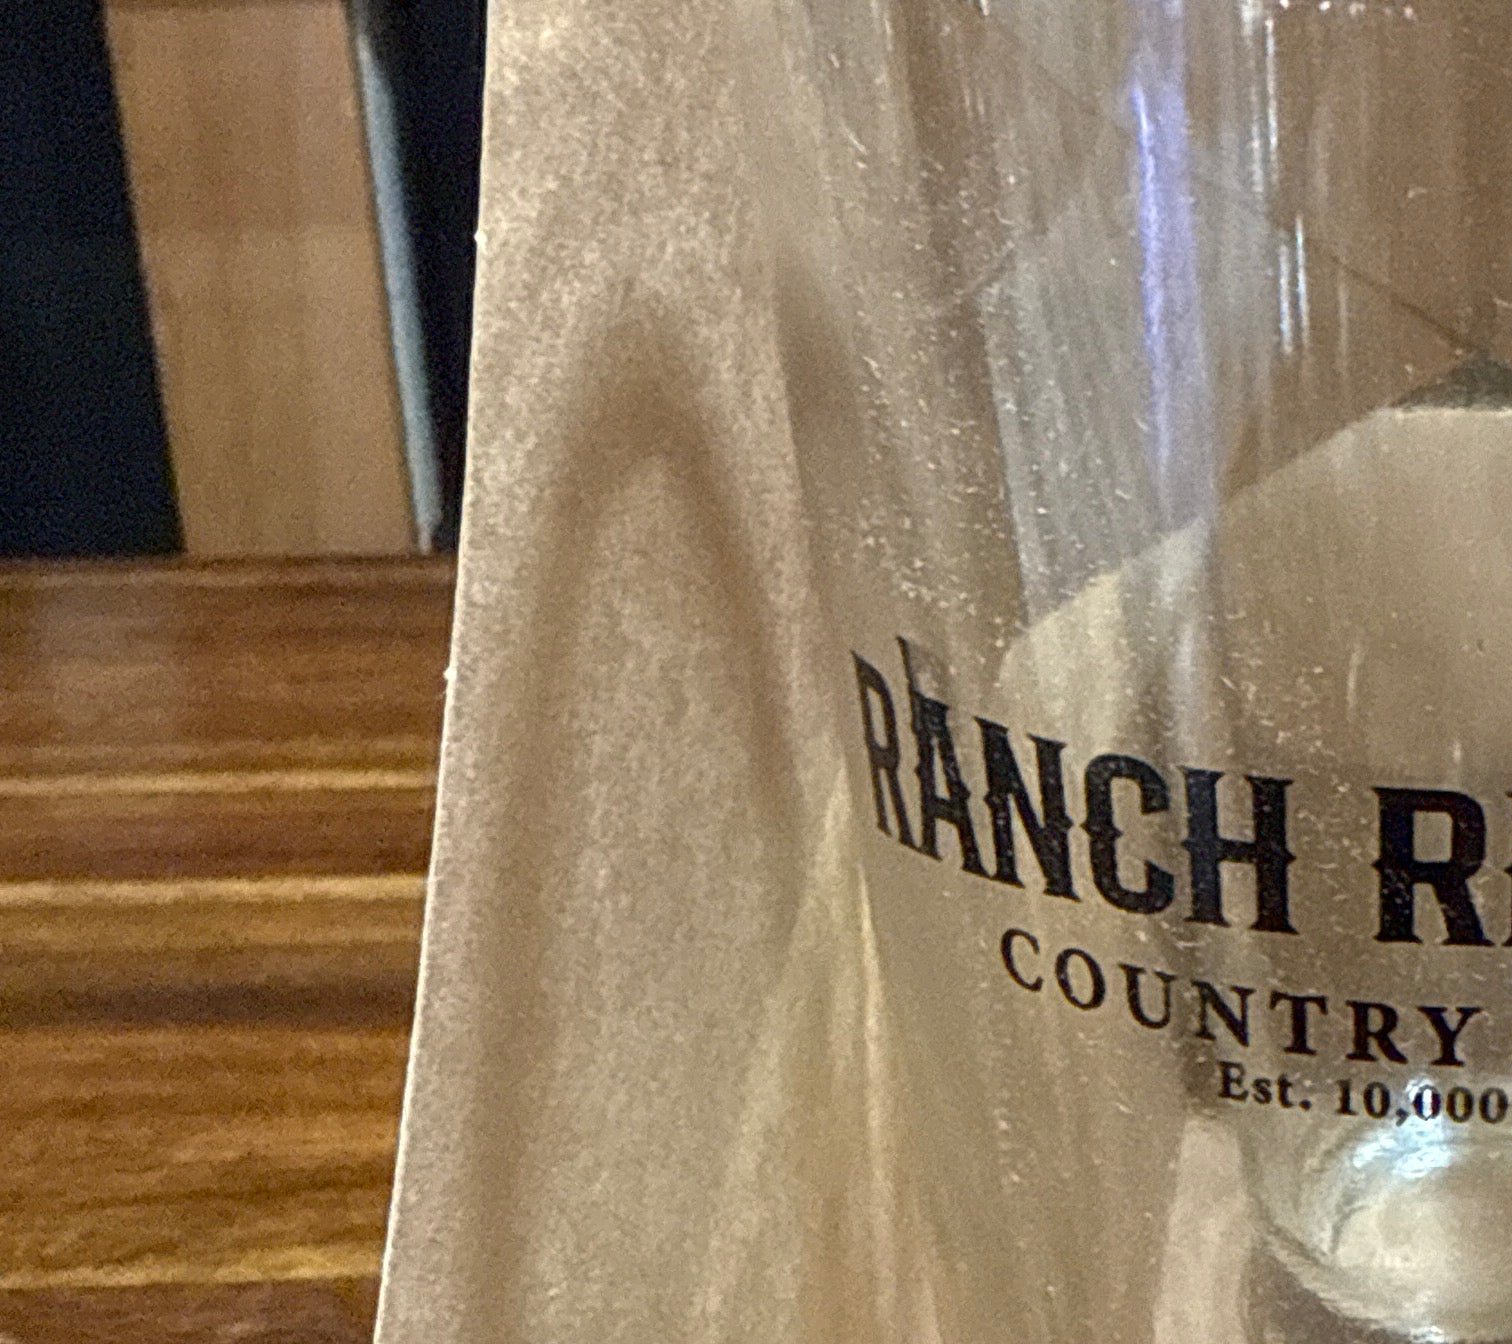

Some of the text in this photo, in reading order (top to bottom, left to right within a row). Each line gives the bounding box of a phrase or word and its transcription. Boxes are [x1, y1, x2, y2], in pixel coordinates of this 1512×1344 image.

[851, 635, 1300, 936] RANCH
[1000, 927, 1483, 1067] COUNTRY
[1217, 1059, 1313, 1112] Est.
[1335, 1078, 1509, 1127] 10,000
